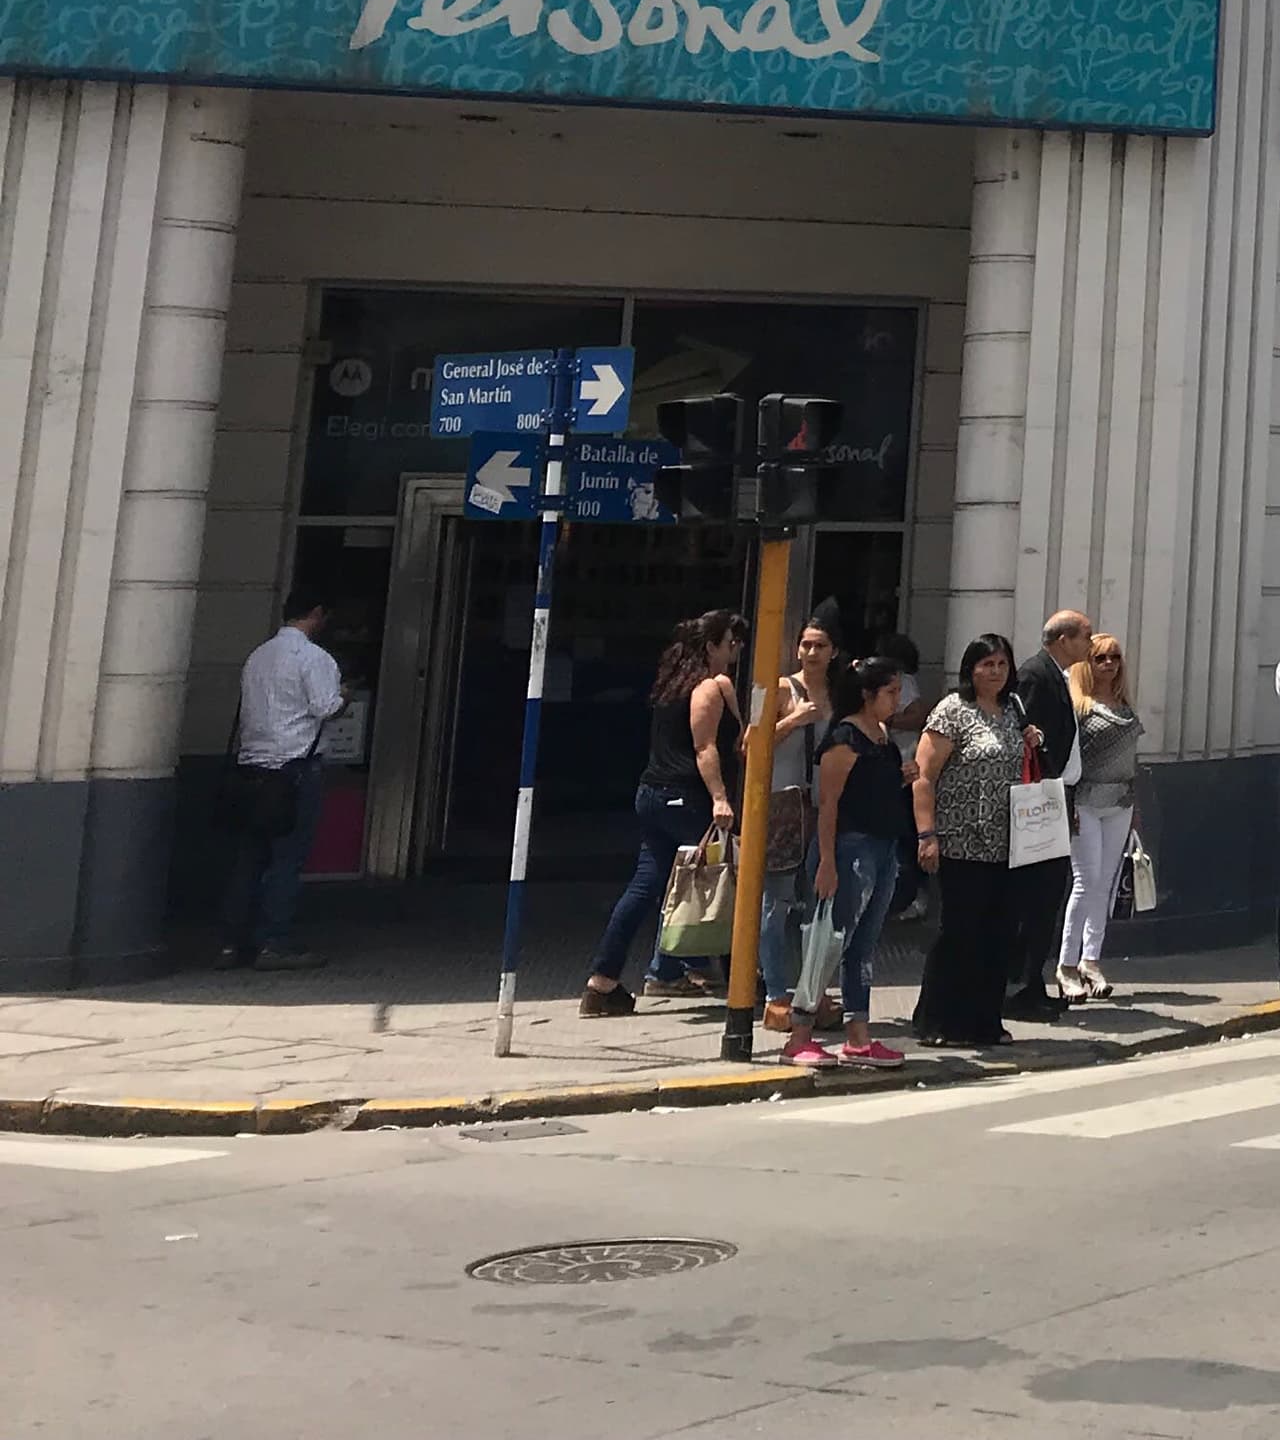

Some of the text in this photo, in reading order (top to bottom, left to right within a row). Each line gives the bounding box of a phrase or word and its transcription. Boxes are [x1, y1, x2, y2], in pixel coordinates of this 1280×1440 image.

[442, 359, 494, 379] General
[495, 357, 524, 380] José
[531, 357, 543, 375] de
[440, 384, 512, 406] San Martín
[439, 413, 540, 433] 700 800
[581, 443, 658, 464] Batalla de
[824, 433, 893, 470] sonal
[578, 471, 619, 492] Junín
[576, 500, 600, 517] 100
